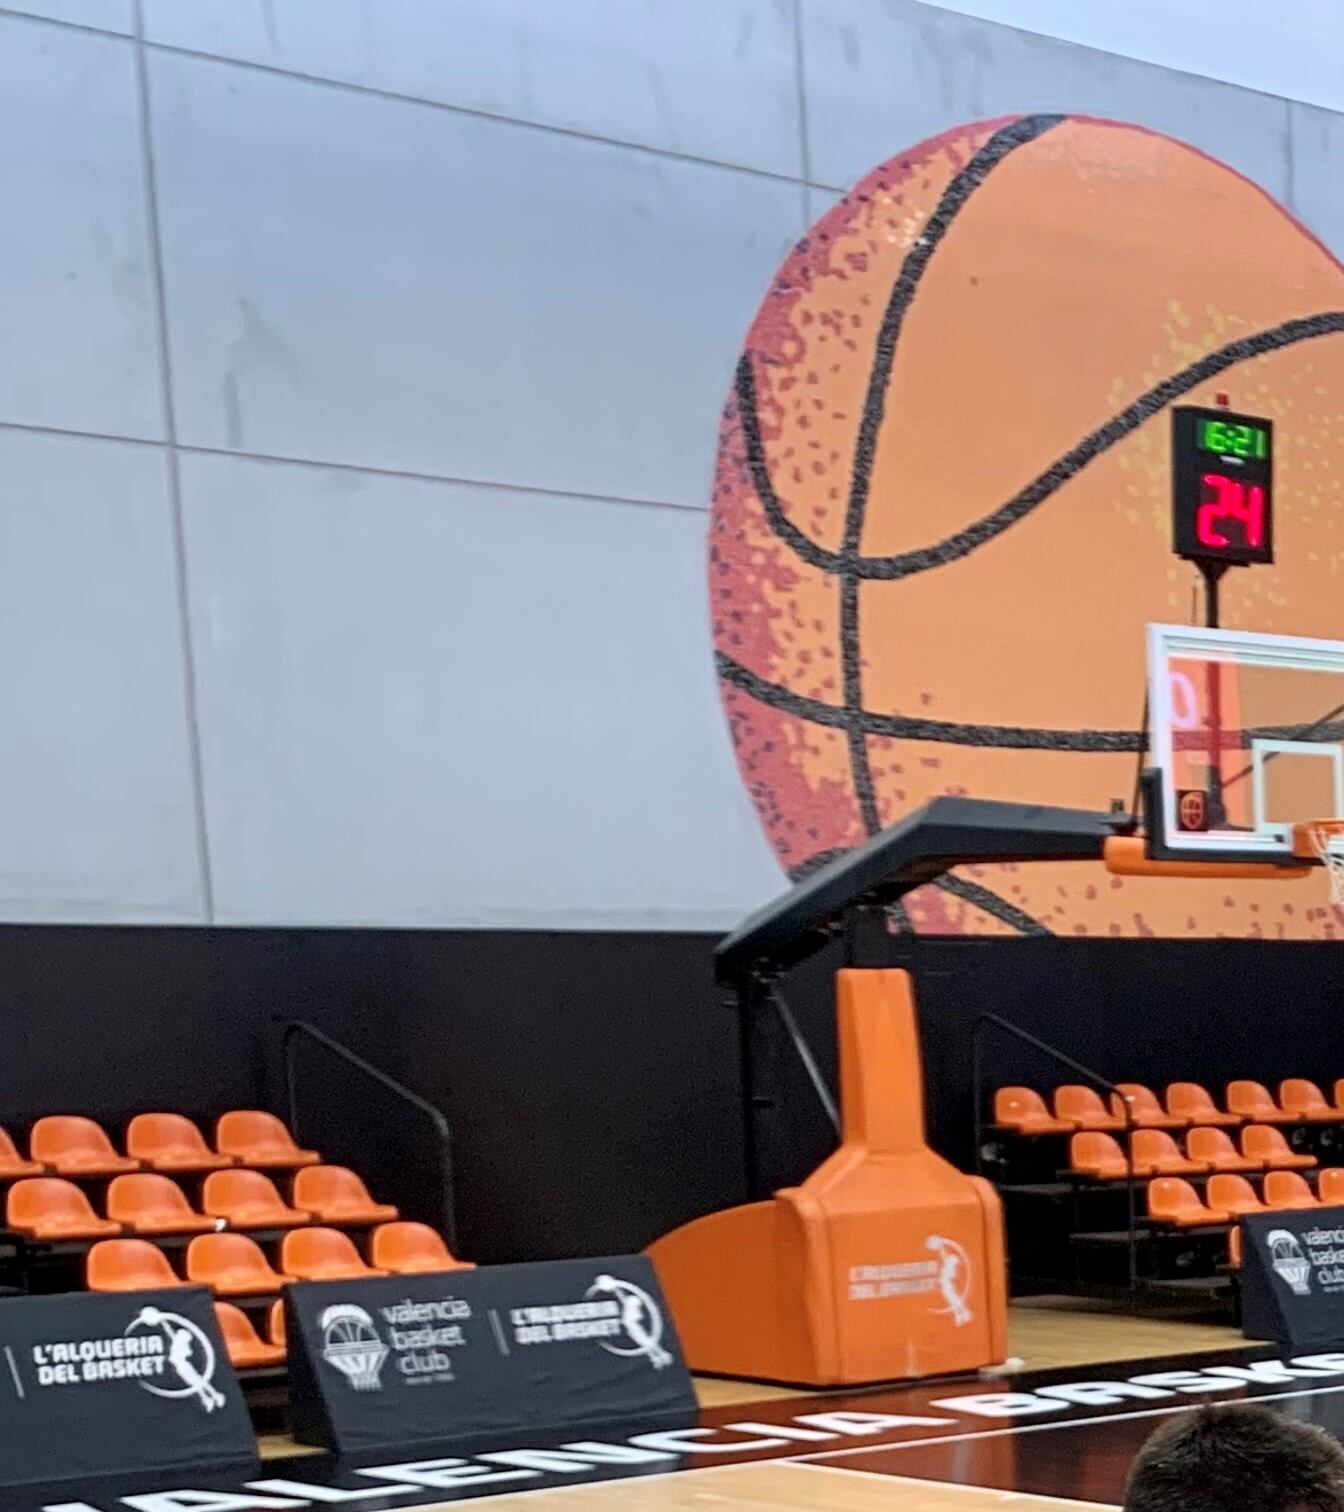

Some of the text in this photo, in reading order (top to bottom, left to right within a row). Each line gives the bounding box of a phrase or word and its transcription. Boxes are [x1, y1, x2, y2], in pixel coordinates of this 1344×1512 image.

[1196, 473, 1264, 547] 24
[380, 1296, 471, 1324] valencia
[33, 1335, 164, 1365] L'ALQUERIA
[389, 1326, 465, 1350] basket
[37, 1355, 165, 1386] DEL BASKET
[399, 1351, 450, 1375] club
